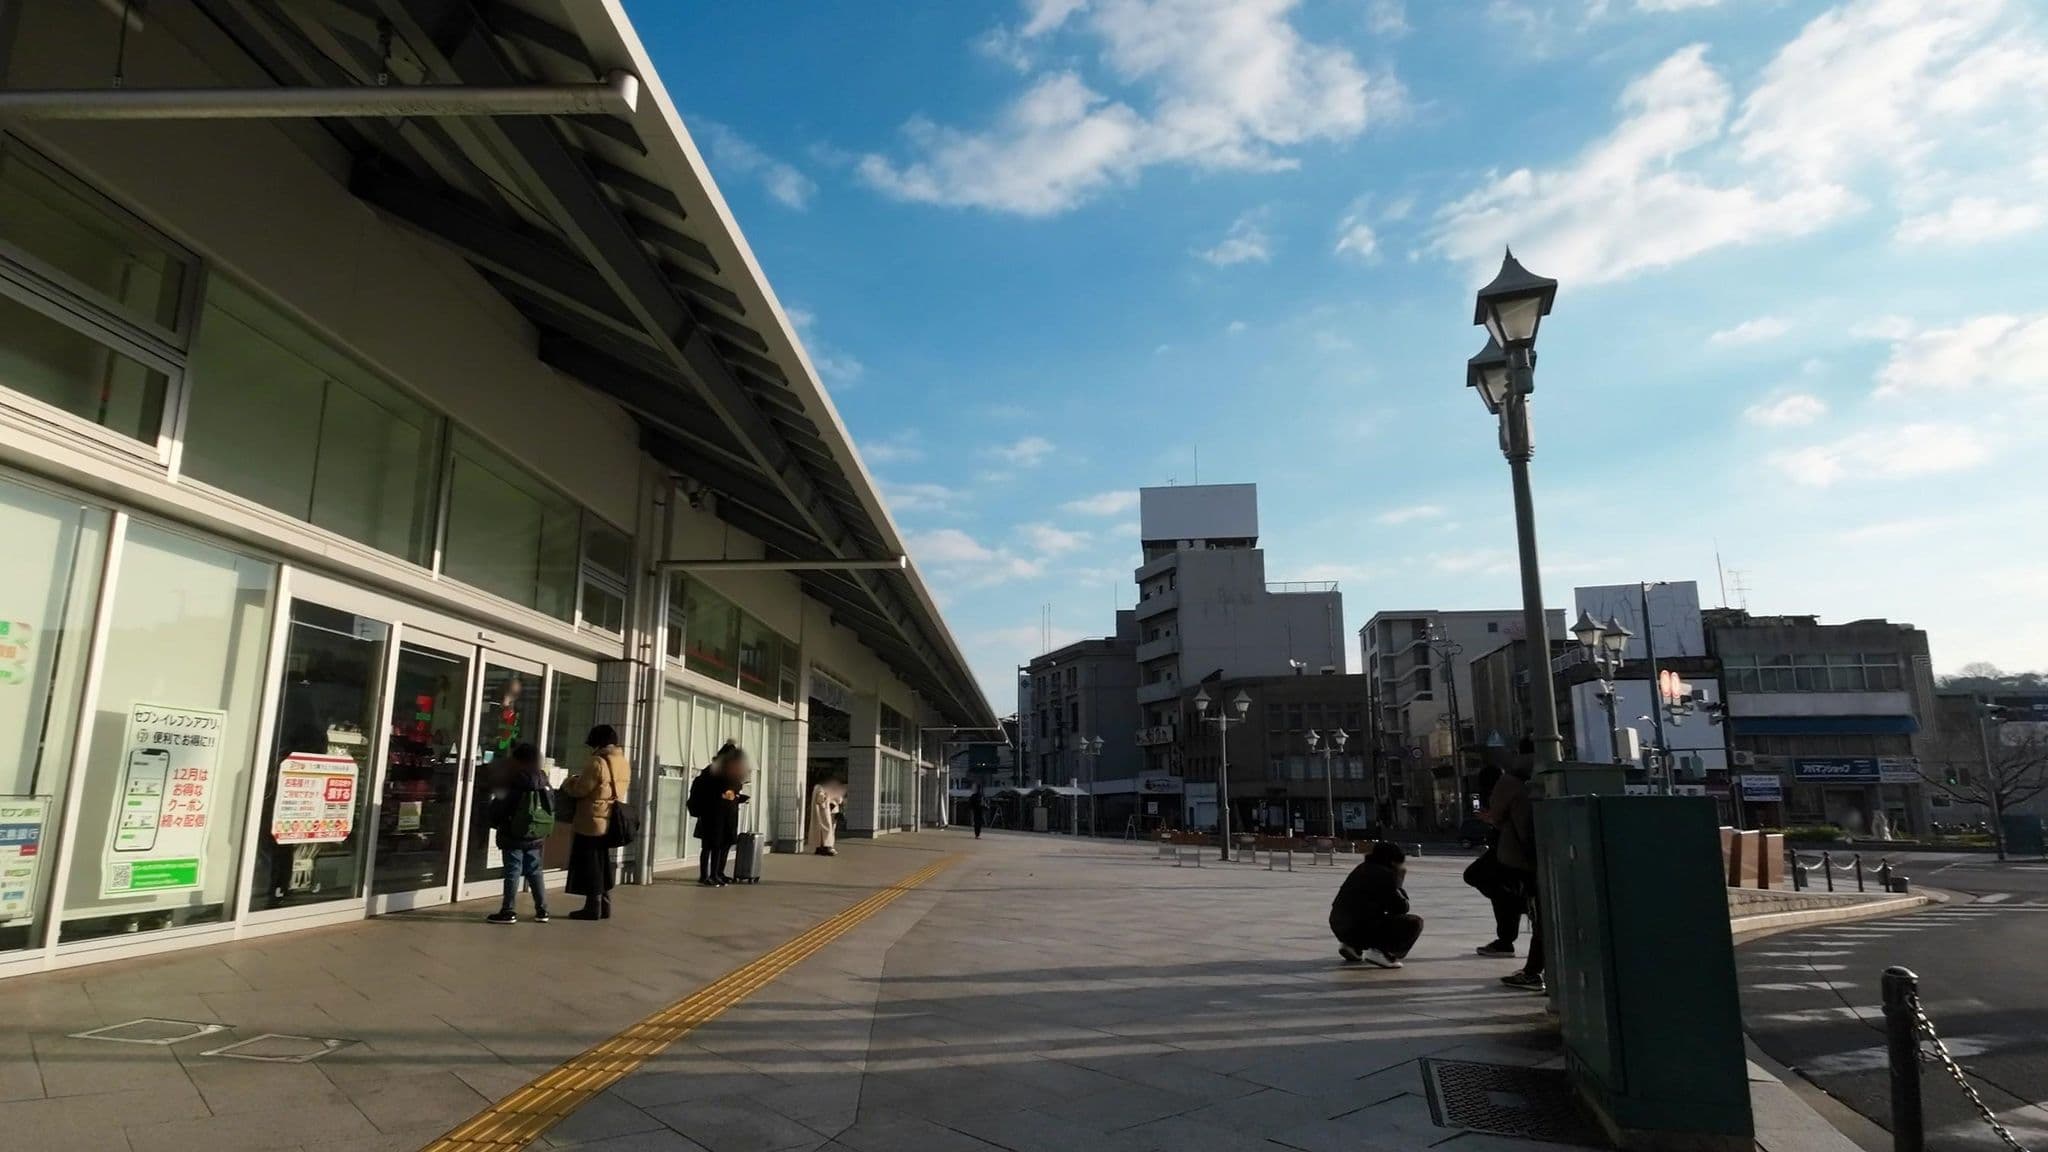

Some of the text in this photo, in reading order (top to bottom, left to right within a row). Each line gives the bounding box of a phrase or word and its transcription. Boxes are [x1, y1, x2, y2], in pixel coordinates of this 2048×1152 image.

[172, 768, 208, 781] 12月は
[172, 783, 203, 797] お得な
[168, 799, 205, 811] クーポン
